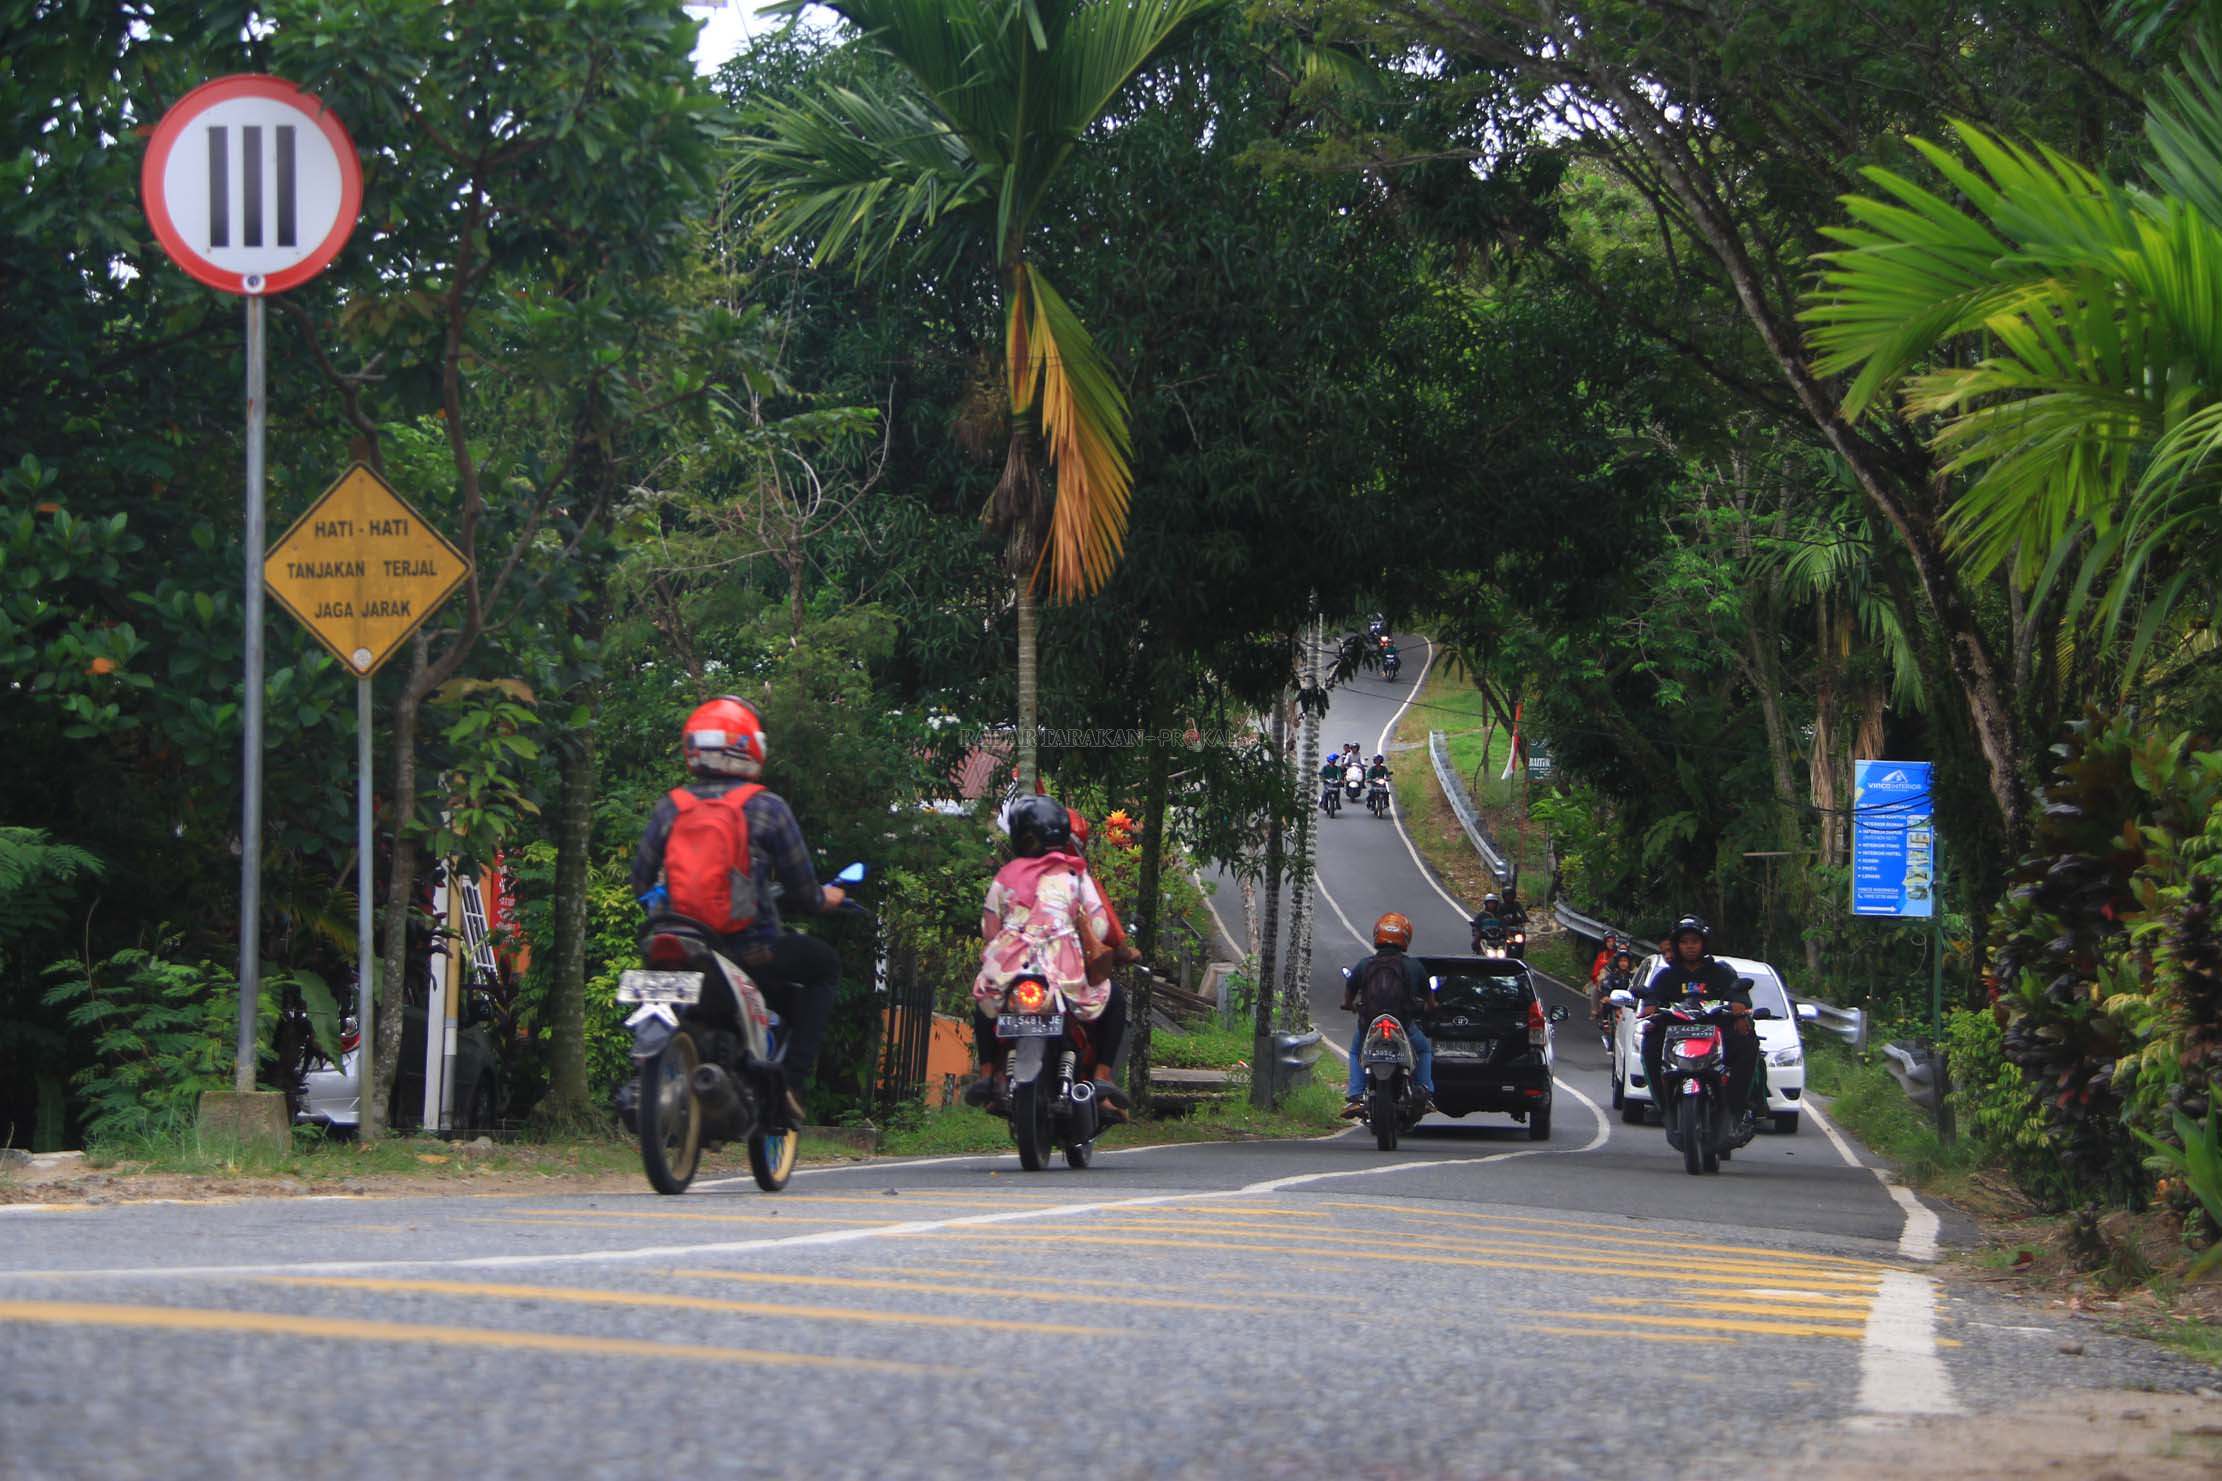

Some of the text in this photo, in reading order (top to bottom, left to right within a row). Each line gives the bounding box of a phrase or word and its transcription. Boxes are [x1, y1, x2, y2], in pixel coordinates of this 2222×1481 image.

[315, 521, 353, 538] HATI
[369, 519, 409, 537] HATI
[287, 559, 438, 579] TANJAKAN TERJAL
[315, 600, 412, 619] JAGA JARAK
[998, 1015, 1063, 1025] KT 5481 JE
